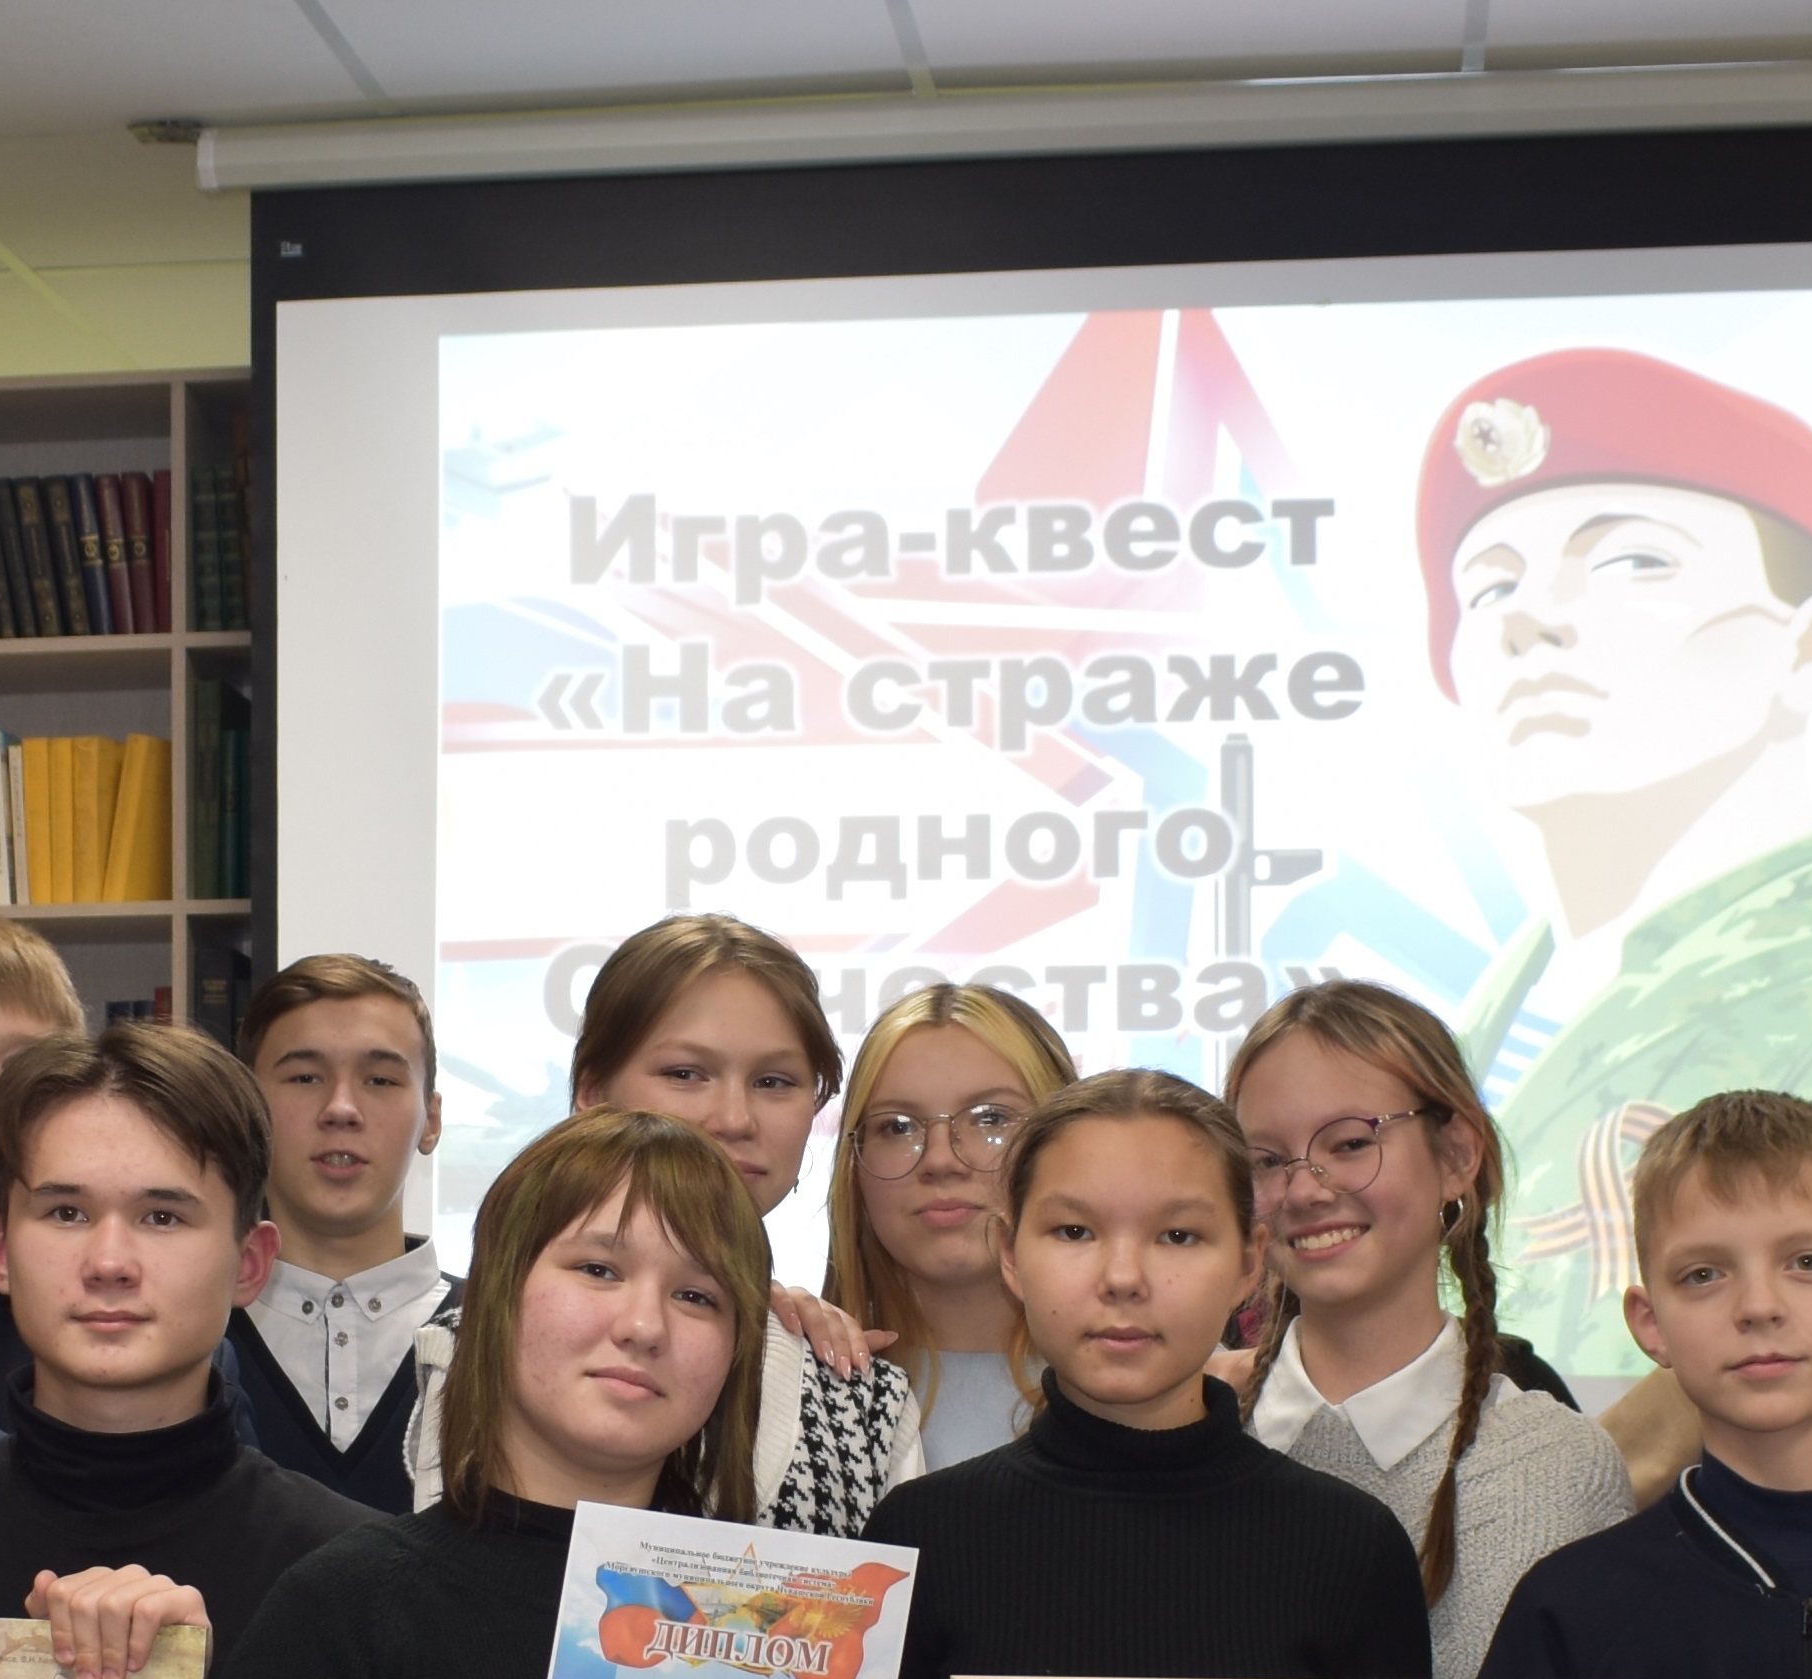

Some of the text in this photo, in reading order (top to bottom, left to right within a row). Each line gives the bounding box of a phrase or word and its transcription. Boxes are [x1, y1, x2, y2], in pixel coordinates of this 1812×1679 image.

[568, 493, 1336, 608] Игра-квест
[537, 639, 1366, 753] «На страже
[667, 809, 1231, 909] родного
[647, 1621, 831, 1673] ДИПЛОМ
